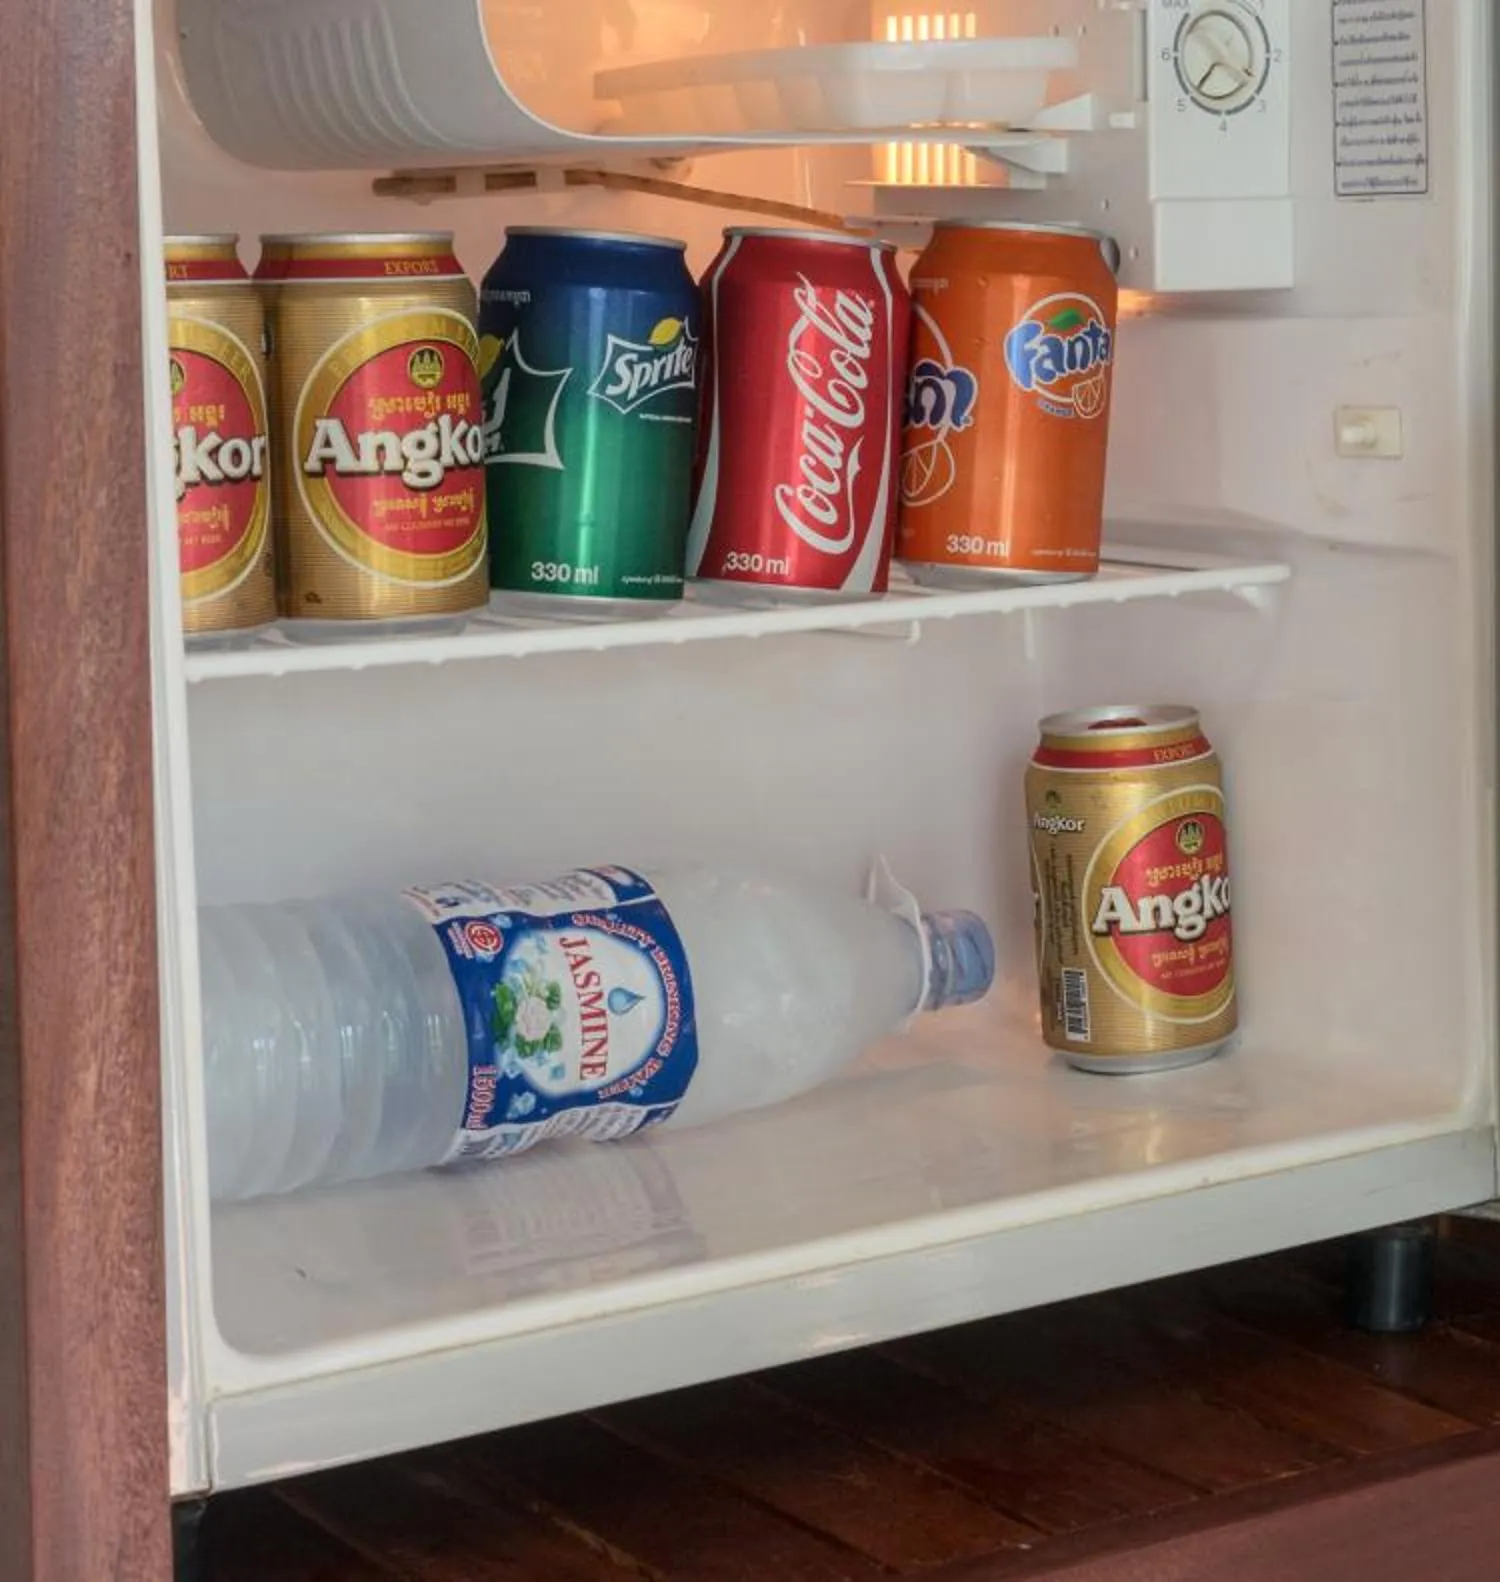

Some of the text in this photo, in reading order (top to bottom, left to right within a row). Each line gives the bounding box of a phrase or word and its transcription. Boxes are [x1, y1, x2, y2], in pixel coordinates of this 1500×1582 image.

[1161, 47, 1171, 62] 6
[1273, 48, 1283, 63] 2
[1176, 98, 1186, 113] 5
[1219, 119, 1228, 132] 4
[383, 260, 440, 276] EXPORT
[1003, 318, 1114, 393] Fanta
[604, 336, 694, 402] Sprite
[773, 271, 878, 556] Coca-Cola
[175, 424, 268, 502] kor
[302, 412, 486, 490] Angko
[946, 535, 1010, 558] 330 ml
[530, 561, 571, 582] 330
[574, 565, 599, 585] ml
[727, 551, 790, 576] 330 ml
[1153, 743, 1196, 763] EXPORT
[1033, 810, 1086, 834] Angkor
[1091, 873, 1231, 941] Angko
[559, 935, 609, 1081] JASMINE
